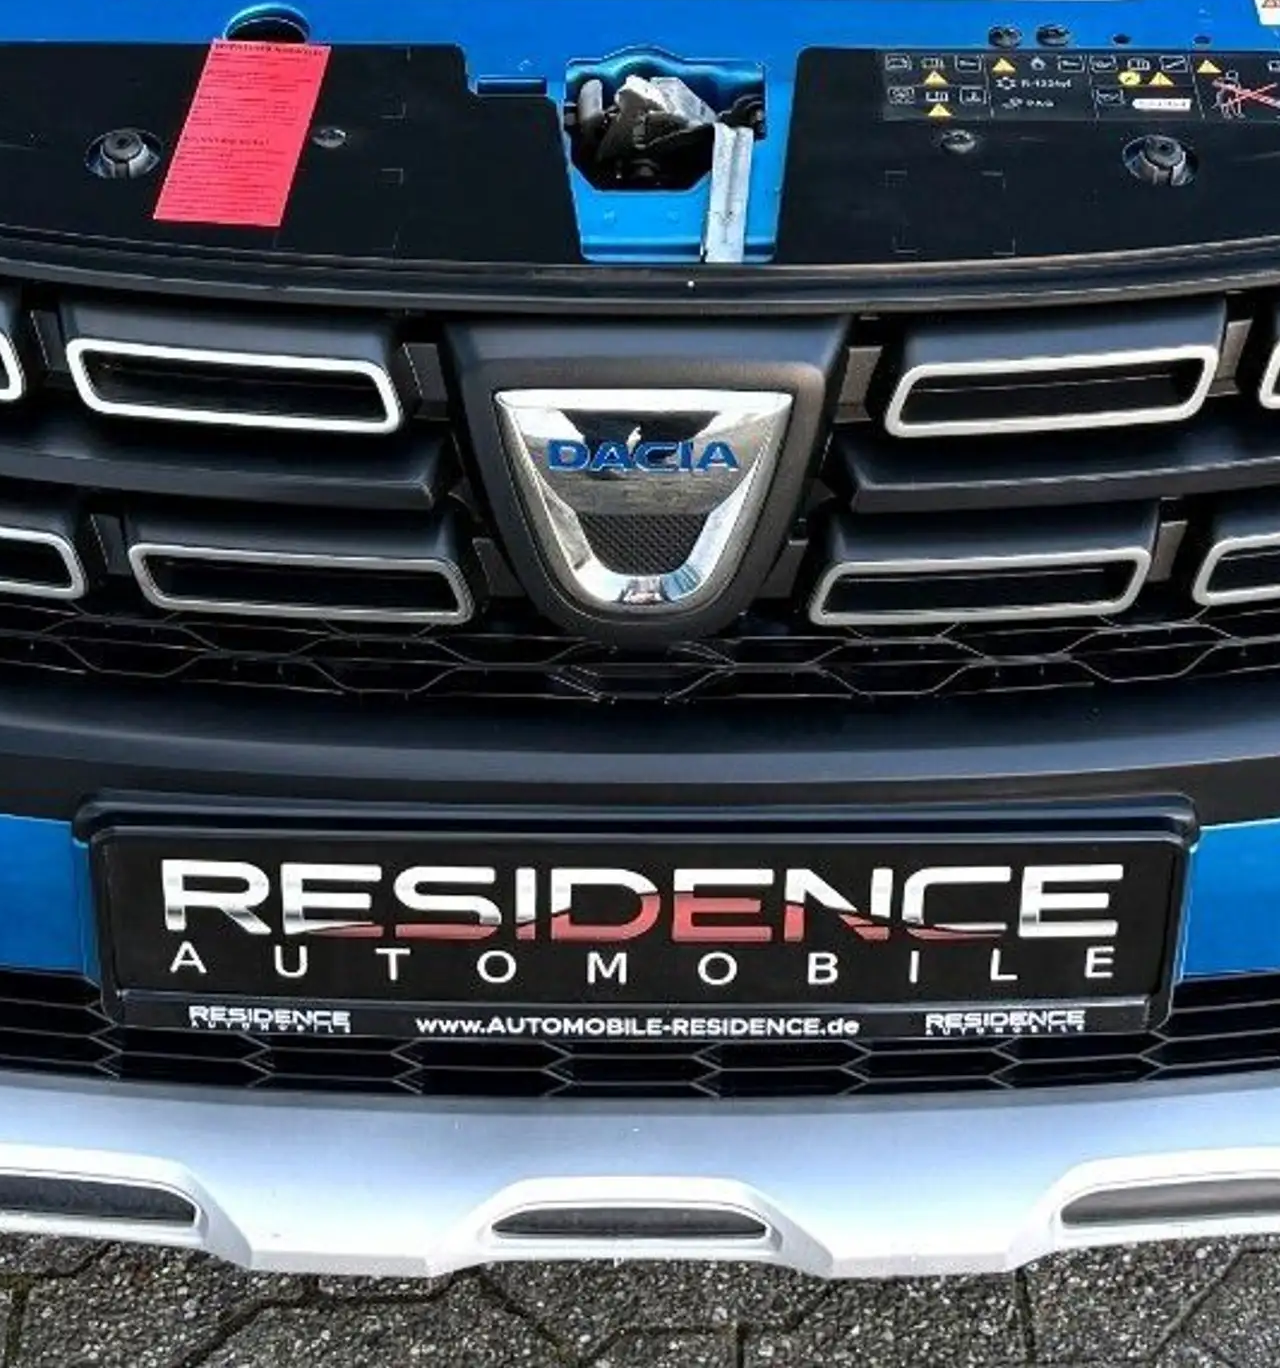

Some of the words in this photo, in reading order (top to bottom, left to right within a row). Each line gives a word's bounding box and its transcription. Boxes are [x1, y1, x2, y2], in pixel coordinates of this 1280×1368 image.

[546, 438, 740, 472] DACIA
[160, 858, 1124, 943] RESIDENCE
[168, 942, 1114, 986] AUTOMOBILE
[188, 1005, 352, 1027] RESIDENCE
[415, 1014, 861, 1037] www.AUTOMOBILE-RESIDENCE.de
[925, 1009, 1087, 1029] RESIDENCE
